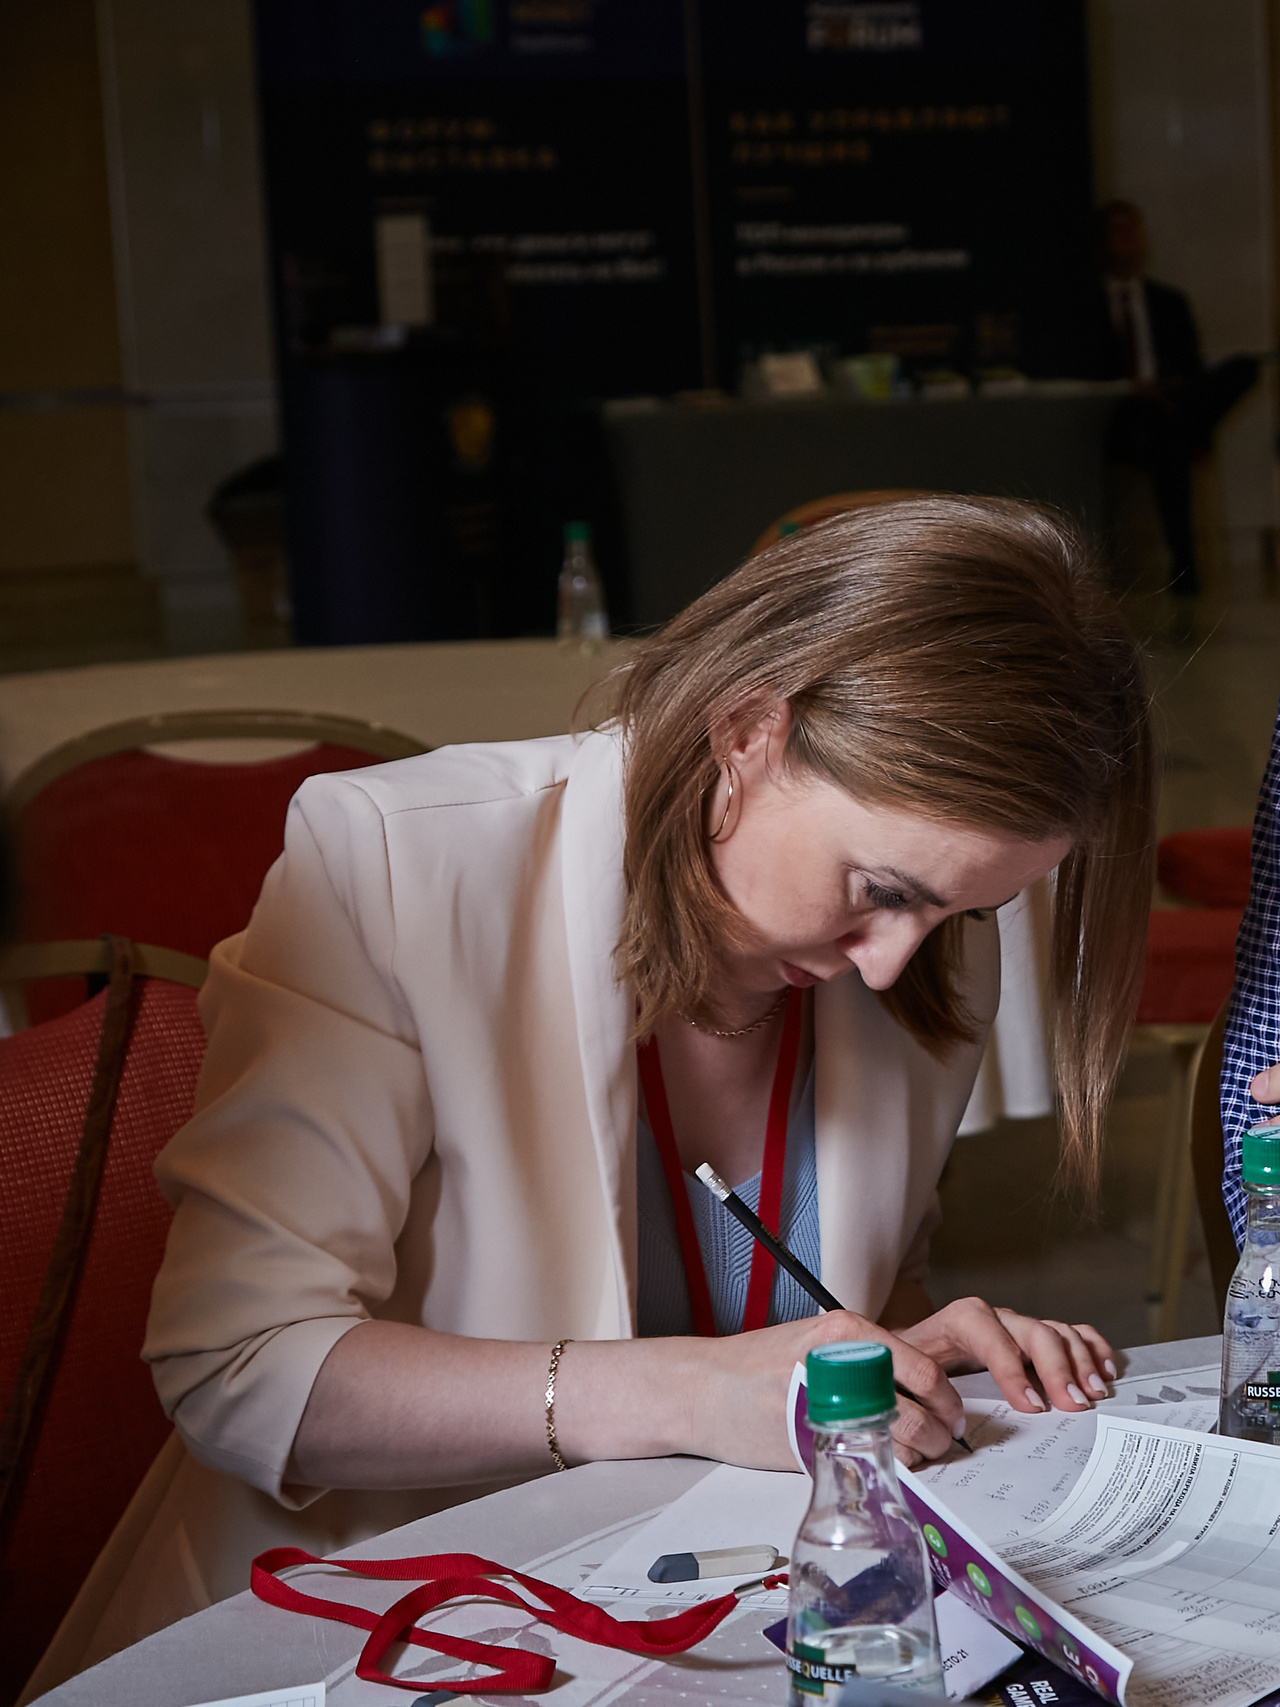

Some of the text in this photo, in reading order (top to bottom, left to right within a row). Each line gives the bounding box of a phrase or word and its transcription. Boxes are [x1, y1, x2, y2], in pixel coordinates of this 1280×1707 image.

[1188, 1443, 1201, 1475] ПРАВИЛА
[1173, 1475, 1193, 1508] ПЕРЕХОДА
[1168, 1508, 1177, 1517] НА
[1030, 1680, 1060, 1705] REAL
